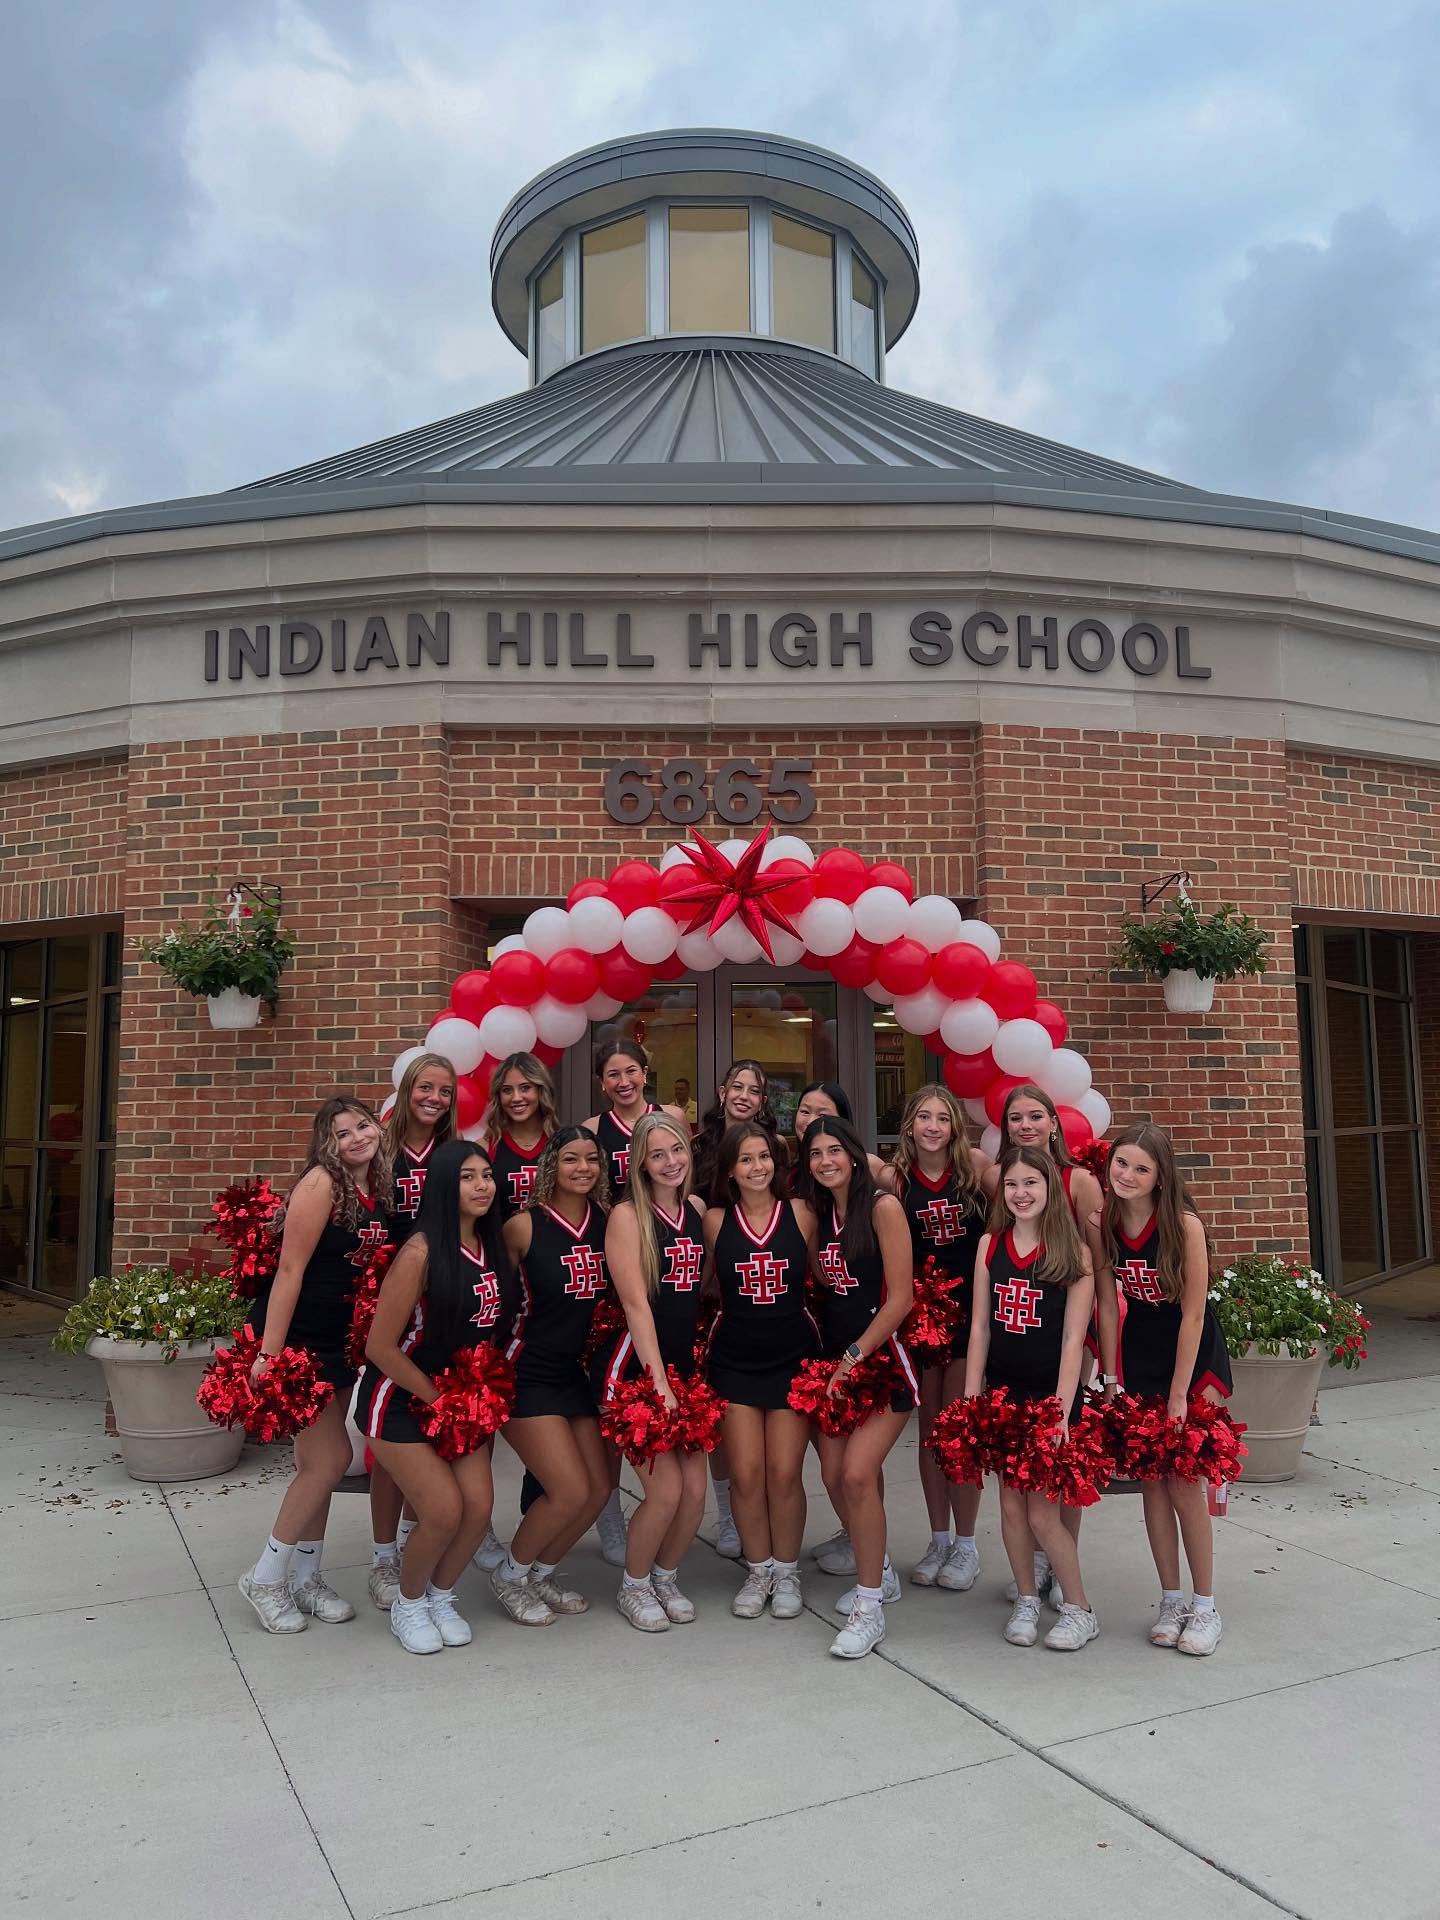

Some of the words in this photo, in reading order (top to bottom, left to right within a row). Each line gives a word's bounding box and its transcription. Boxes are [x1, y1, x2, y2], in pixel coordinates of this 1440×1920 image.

[204, 611, 450, 682] INDIAN
[486, 611, 655, 667] HILL
[688, 611, 873, 668] HIGH
[908, 611, 1212, 679] SCHOOL
[604, 758, 817, 825] 6865
